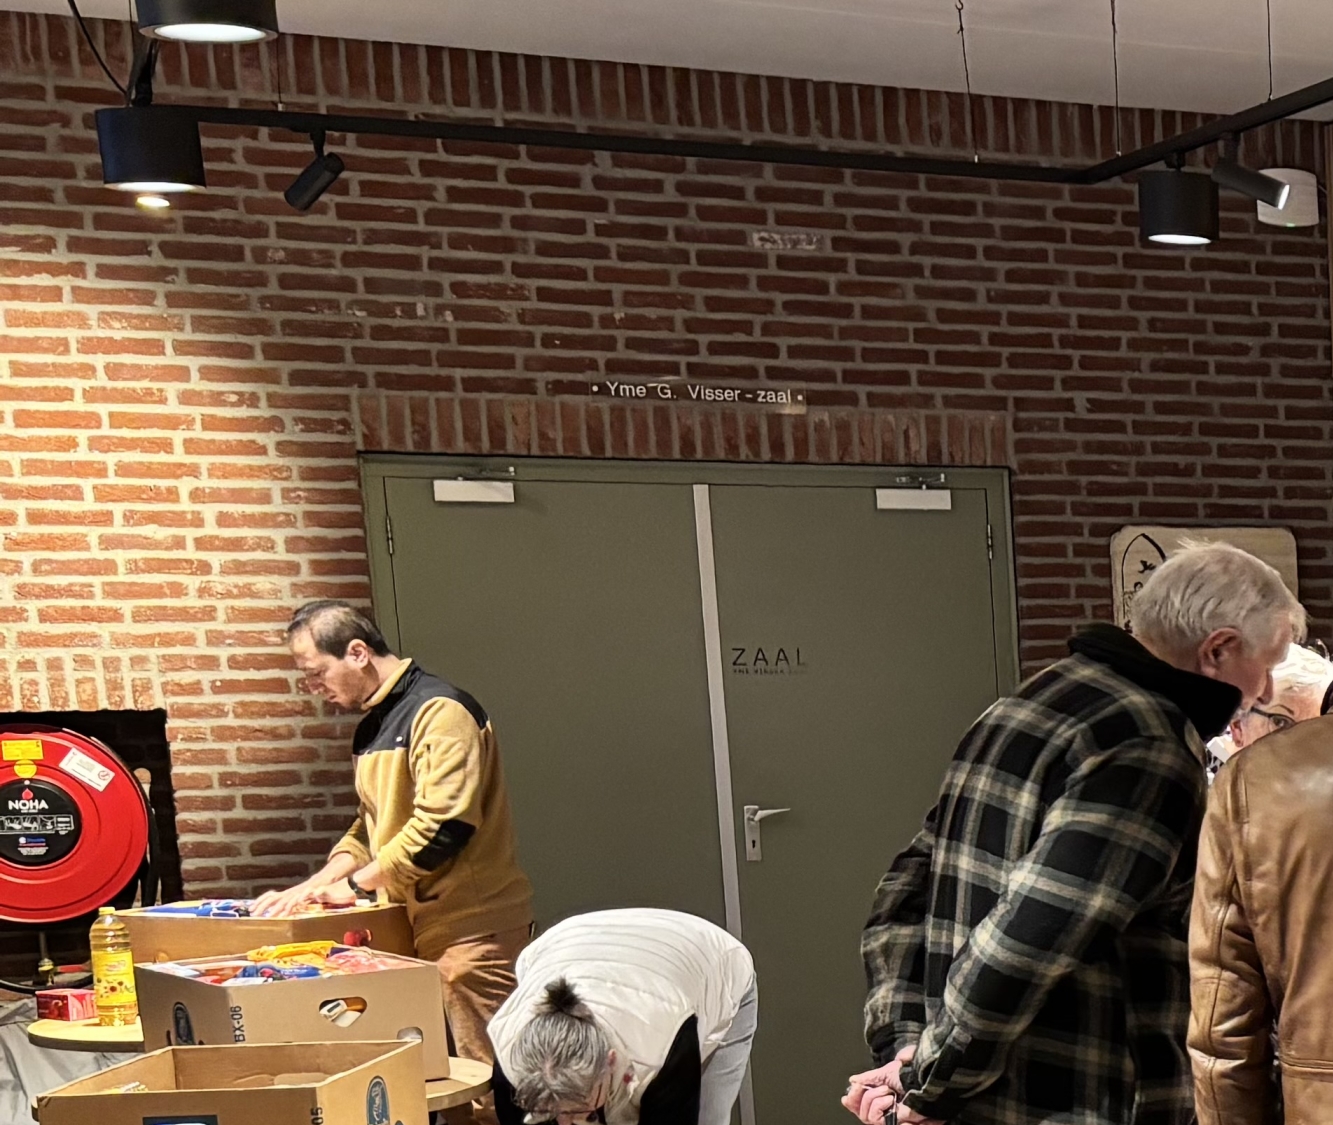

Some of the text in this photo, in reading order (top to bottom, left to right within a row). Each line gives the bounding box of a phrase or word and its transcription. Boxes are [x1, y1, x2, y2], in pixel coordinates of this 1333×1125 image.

[606, 381, 792, 404] Yme G. Visser zaal
[731, 647, 807, 666] ZAAL
[8, 799, 49, 811] NOHA
[230, 1005, 246, 1043] BX-06
